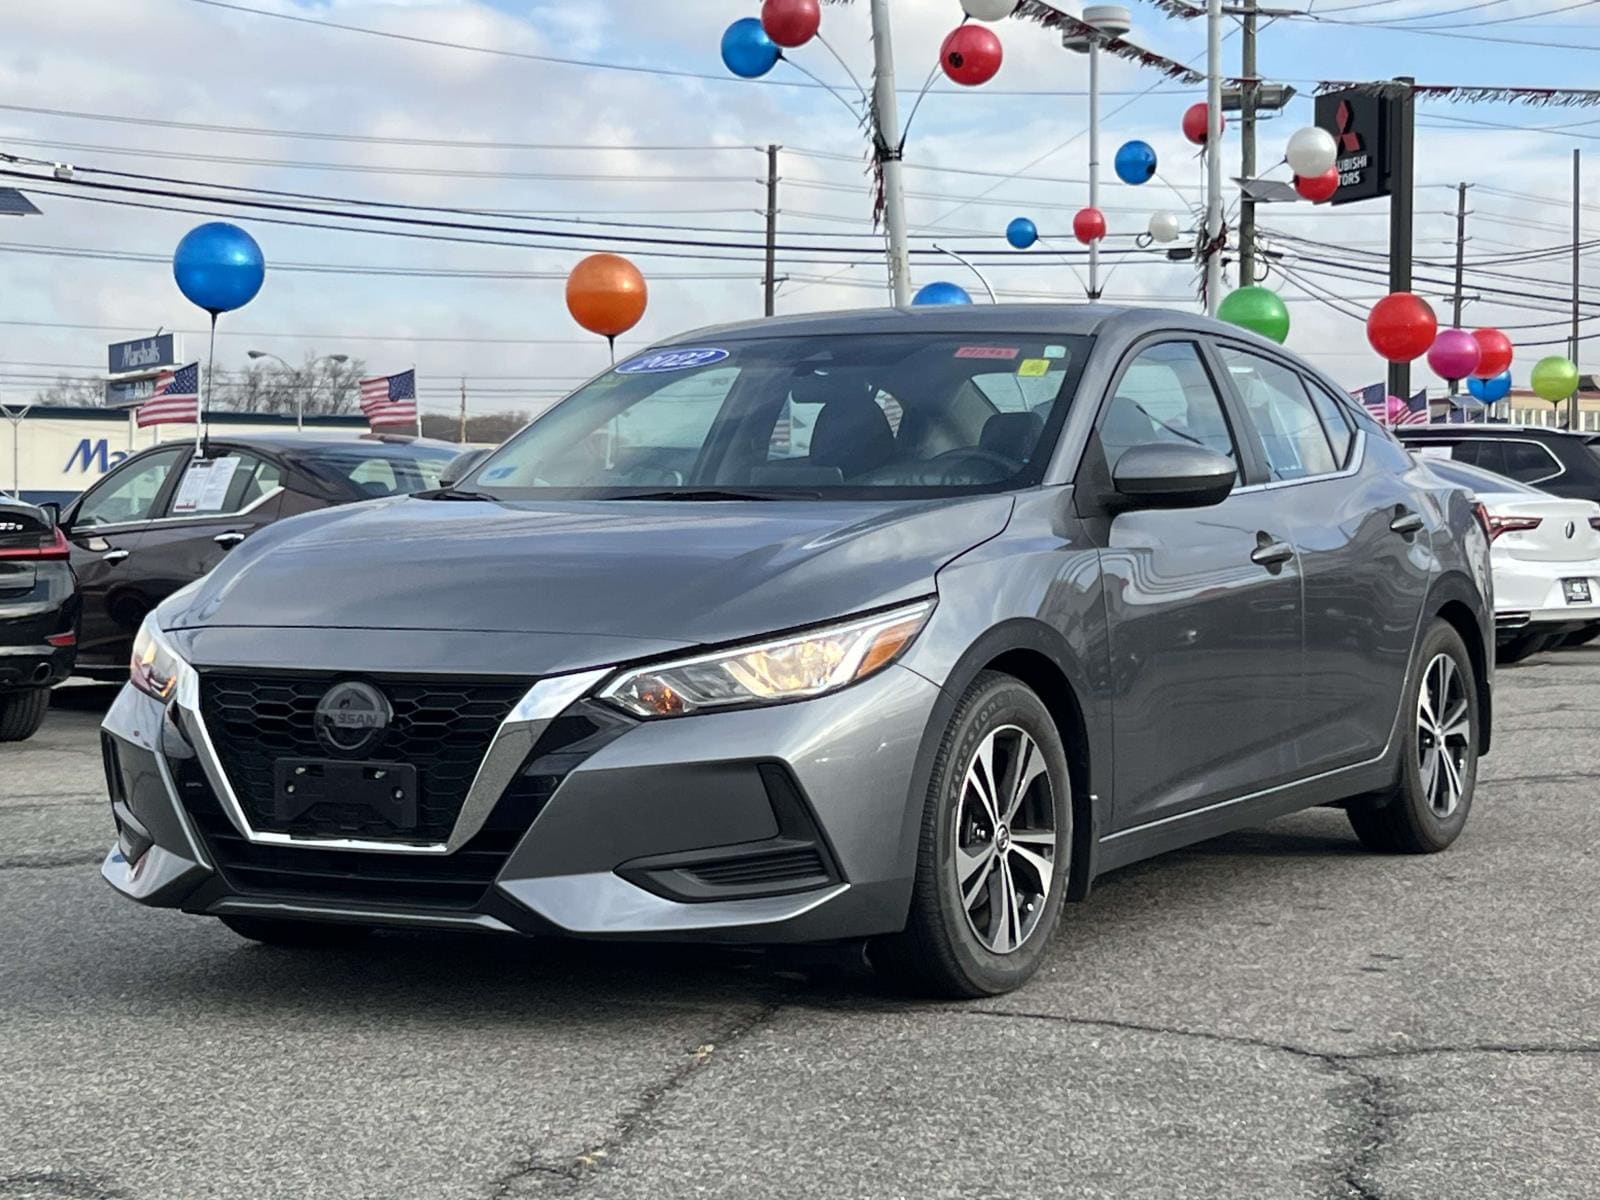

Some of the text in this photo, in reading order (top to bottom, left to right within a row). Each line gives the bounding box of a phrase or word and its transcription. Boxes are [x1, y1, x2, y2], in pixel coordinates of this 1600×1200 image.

[1337, 155, 1367, 172] UBISHI
[1338, 171, 1360, 187] TORS
[121, 340, 160, 368] Marshalls
[630, 351, 715, 371] 2022
